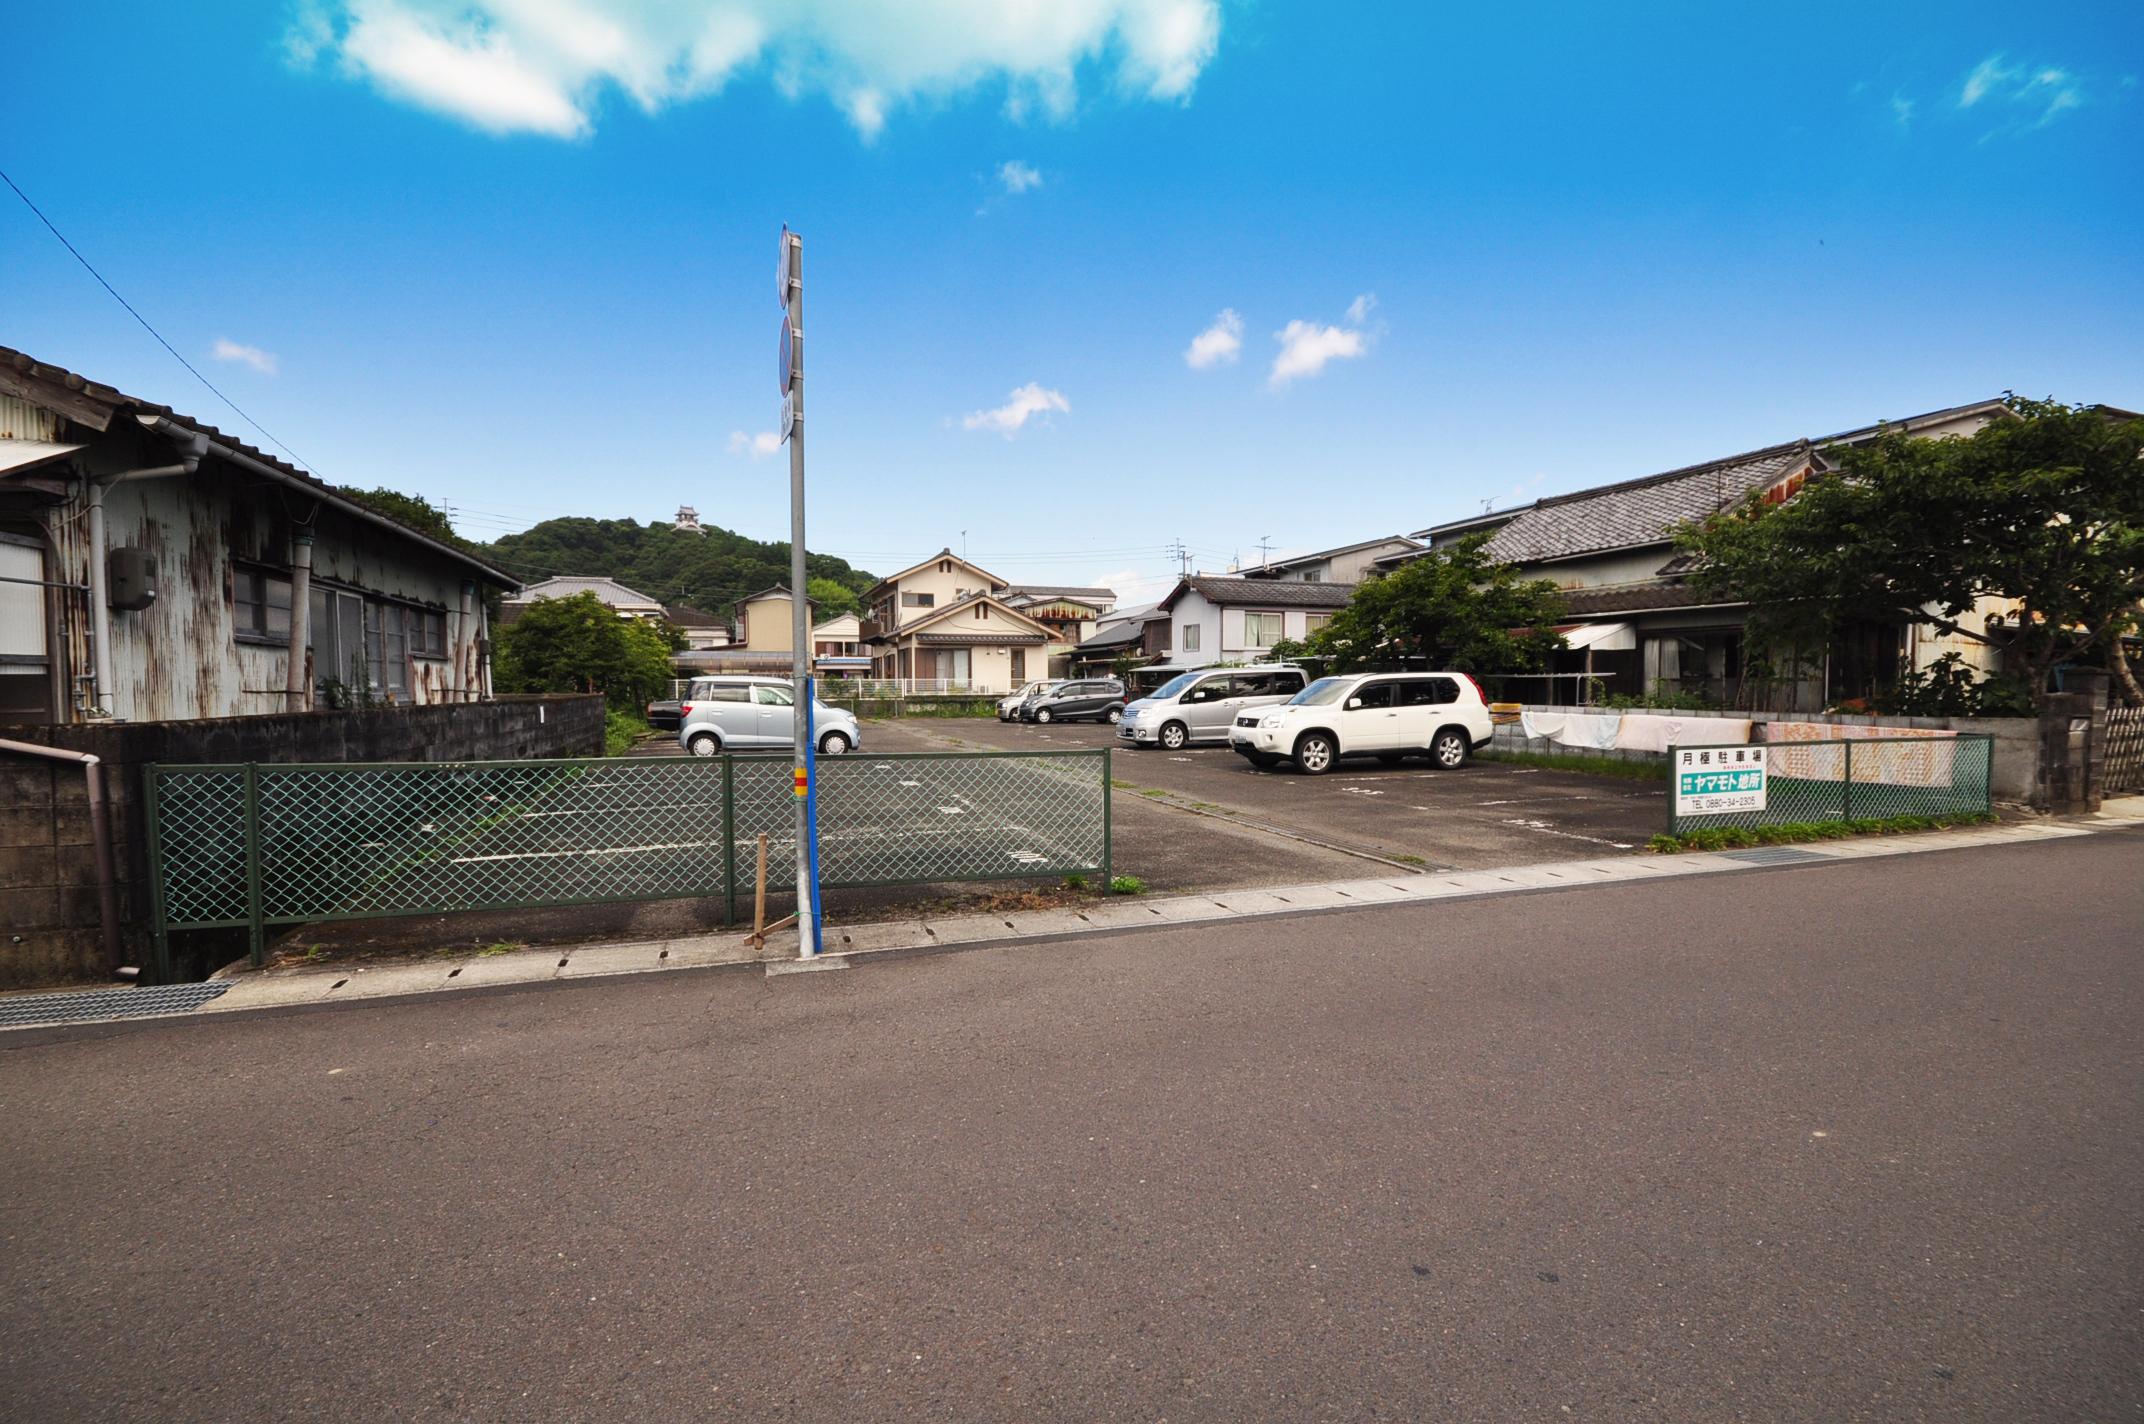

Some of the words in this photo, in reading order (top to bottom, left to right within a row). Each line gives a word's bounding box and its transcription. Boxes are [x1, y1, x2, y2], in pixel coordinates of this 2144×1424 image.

[1683, 750, 1761, 765] 月極駐車場
[1694, 773, 1760, 792] ヤマモト地所
[1692, 800, 1703, 809] TEL
